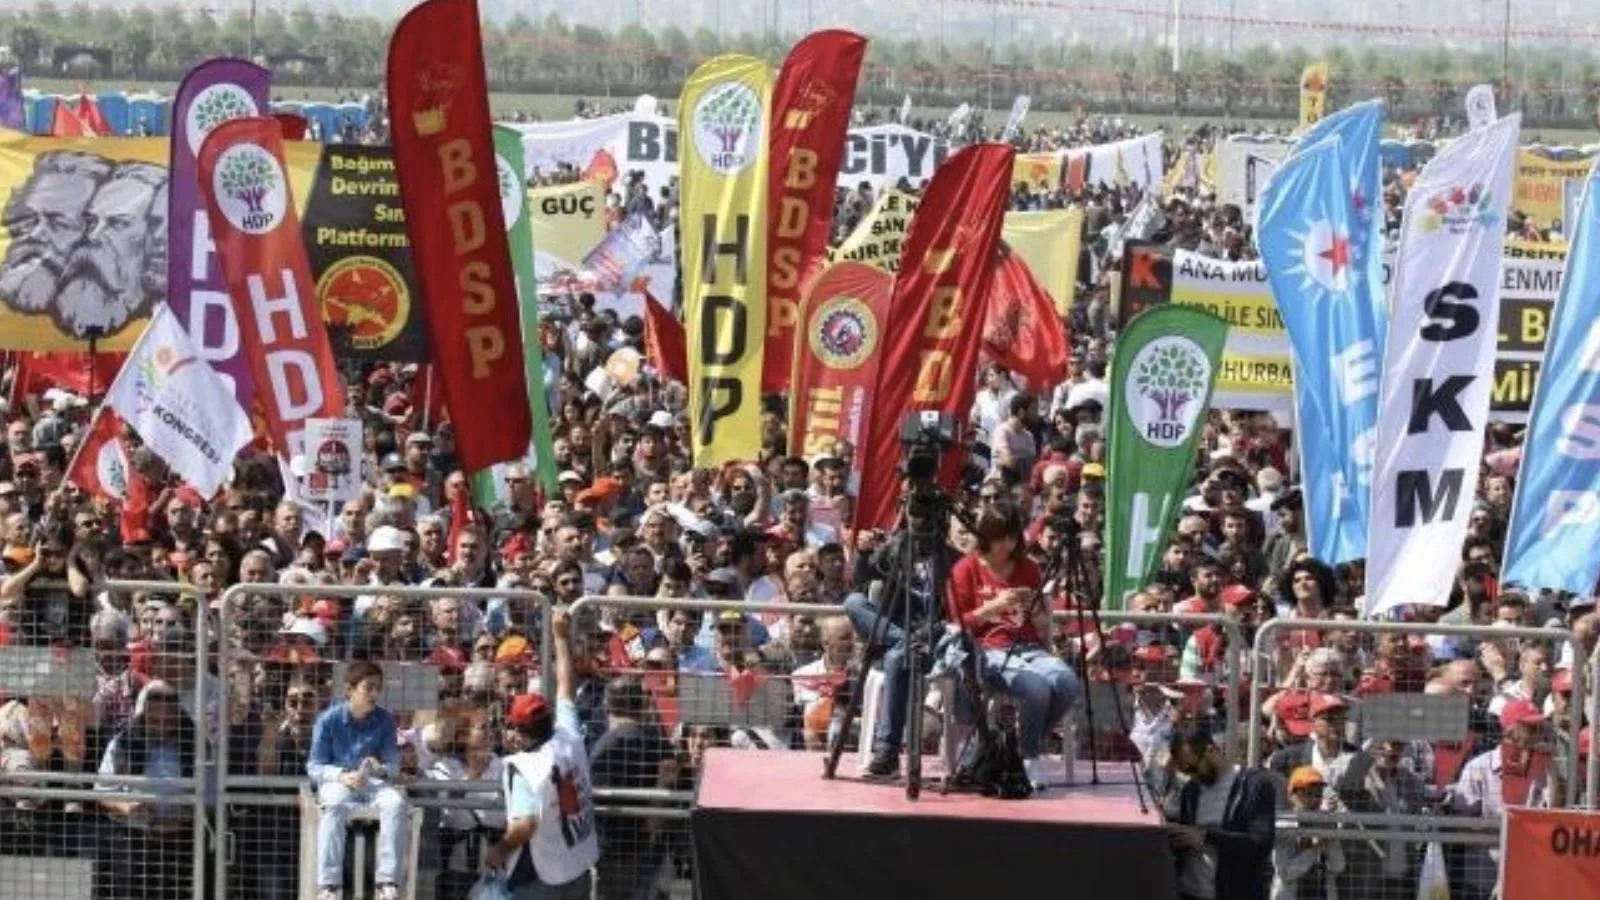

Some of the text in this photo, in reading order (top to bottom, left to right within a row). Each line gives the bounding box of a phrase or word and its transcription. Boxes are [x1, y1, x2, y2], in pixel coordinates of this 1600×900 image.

[242, 212, 274, 230] HDP
[437, 138, 505, 379] BDSP
[541, 193, 595, 219] GÜÇ
[767, 147, 818, 337] BDSP
[1179, 257, 1226, 284] ANA
[700, 213, 750, 447] HDP
[1391, 280, 1481, 530] SKM
